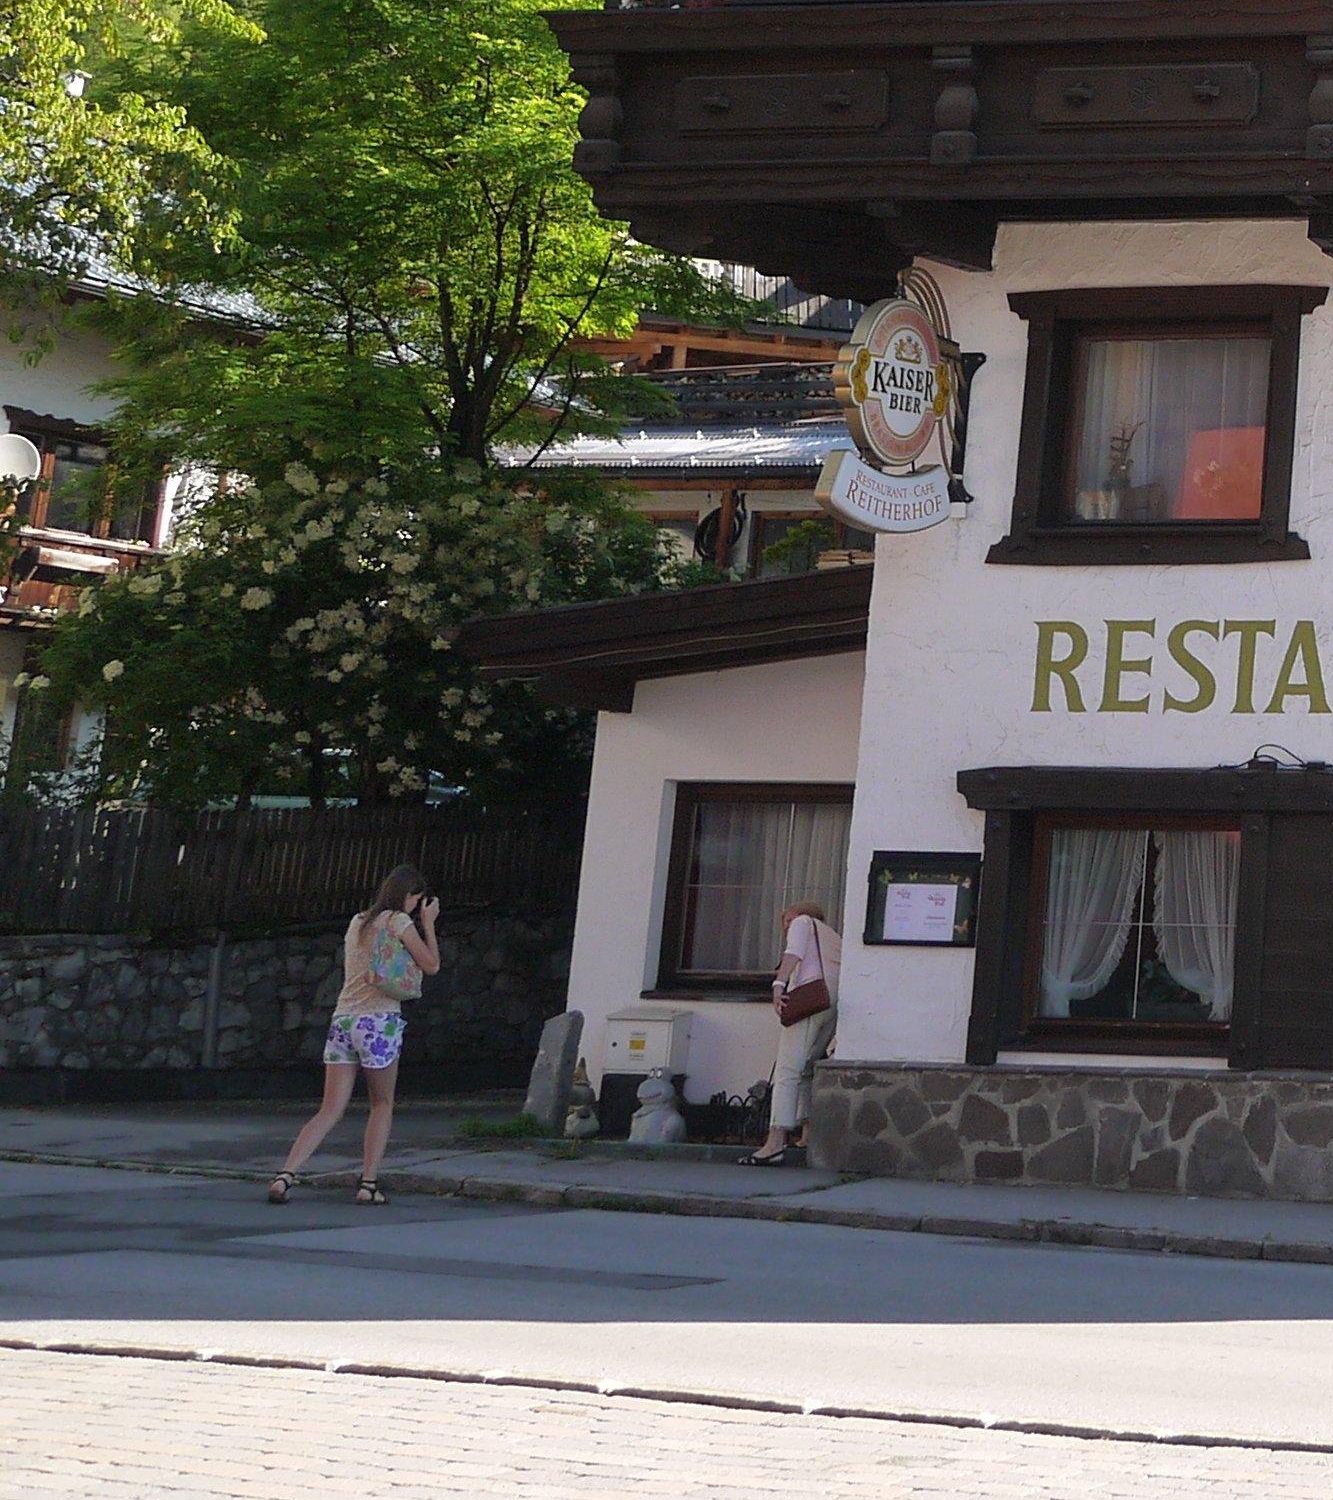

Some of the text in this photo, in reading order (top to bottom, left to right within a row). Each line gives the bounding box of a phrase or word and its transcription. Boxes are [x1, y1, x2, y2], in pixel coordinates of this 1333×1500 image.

[871, 361, 934, 402] KAISER
[889, 392, 922, 415] BIER
[846, 479, 943, 522] REITHERHOF
[855, 469, 936, 499] RESTAURANT CAFE
